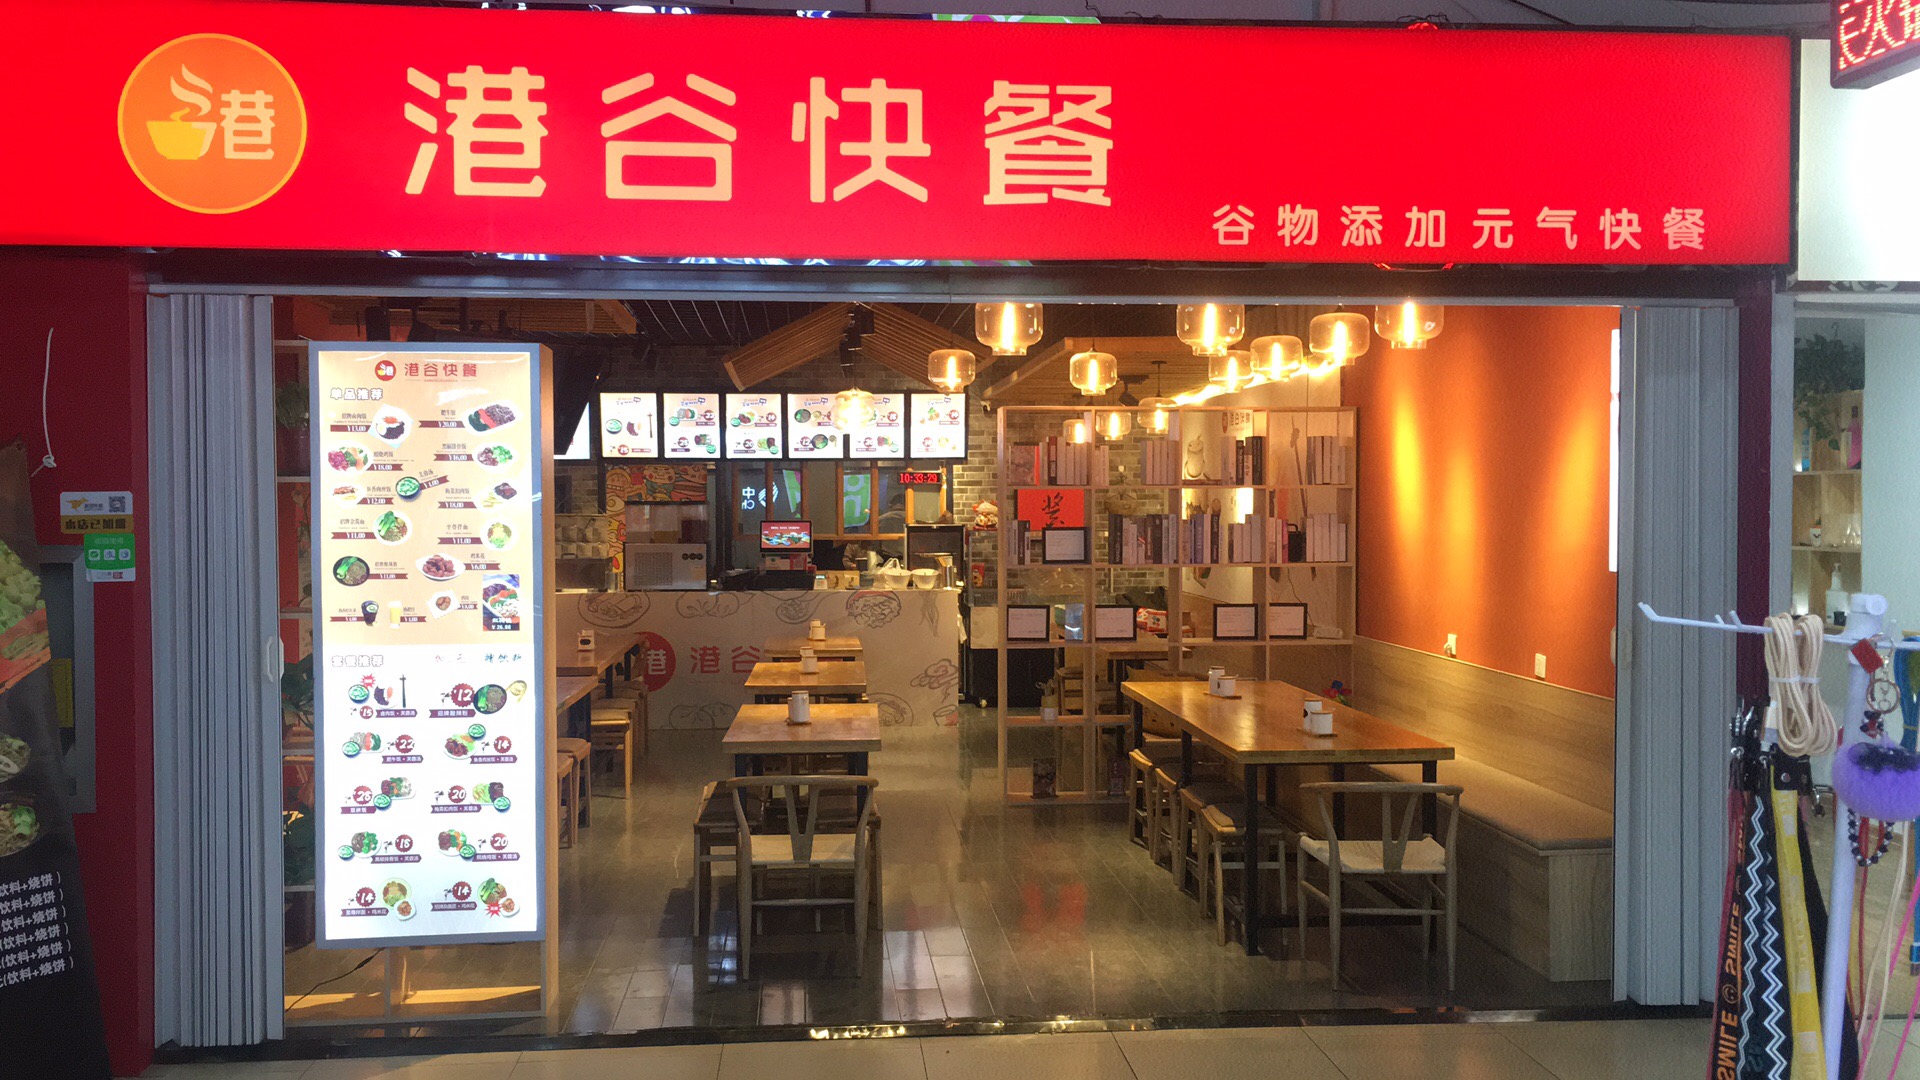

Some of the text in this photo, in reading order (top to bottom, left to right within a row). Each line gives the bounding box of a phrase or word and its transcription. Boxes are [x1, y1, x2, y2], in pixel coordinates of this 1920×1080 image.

[404, 65, 1113, 207] 港谷快餐
[1212, 204, 1705, 251] 谷物添加元气快餐
[404, 362, 477, 377] 港谷快餐
[330, 387, 384, 401] 单品推荐
[900, 473, 937, 483] 10:33:29
[457, 688, 473, 702] 12
